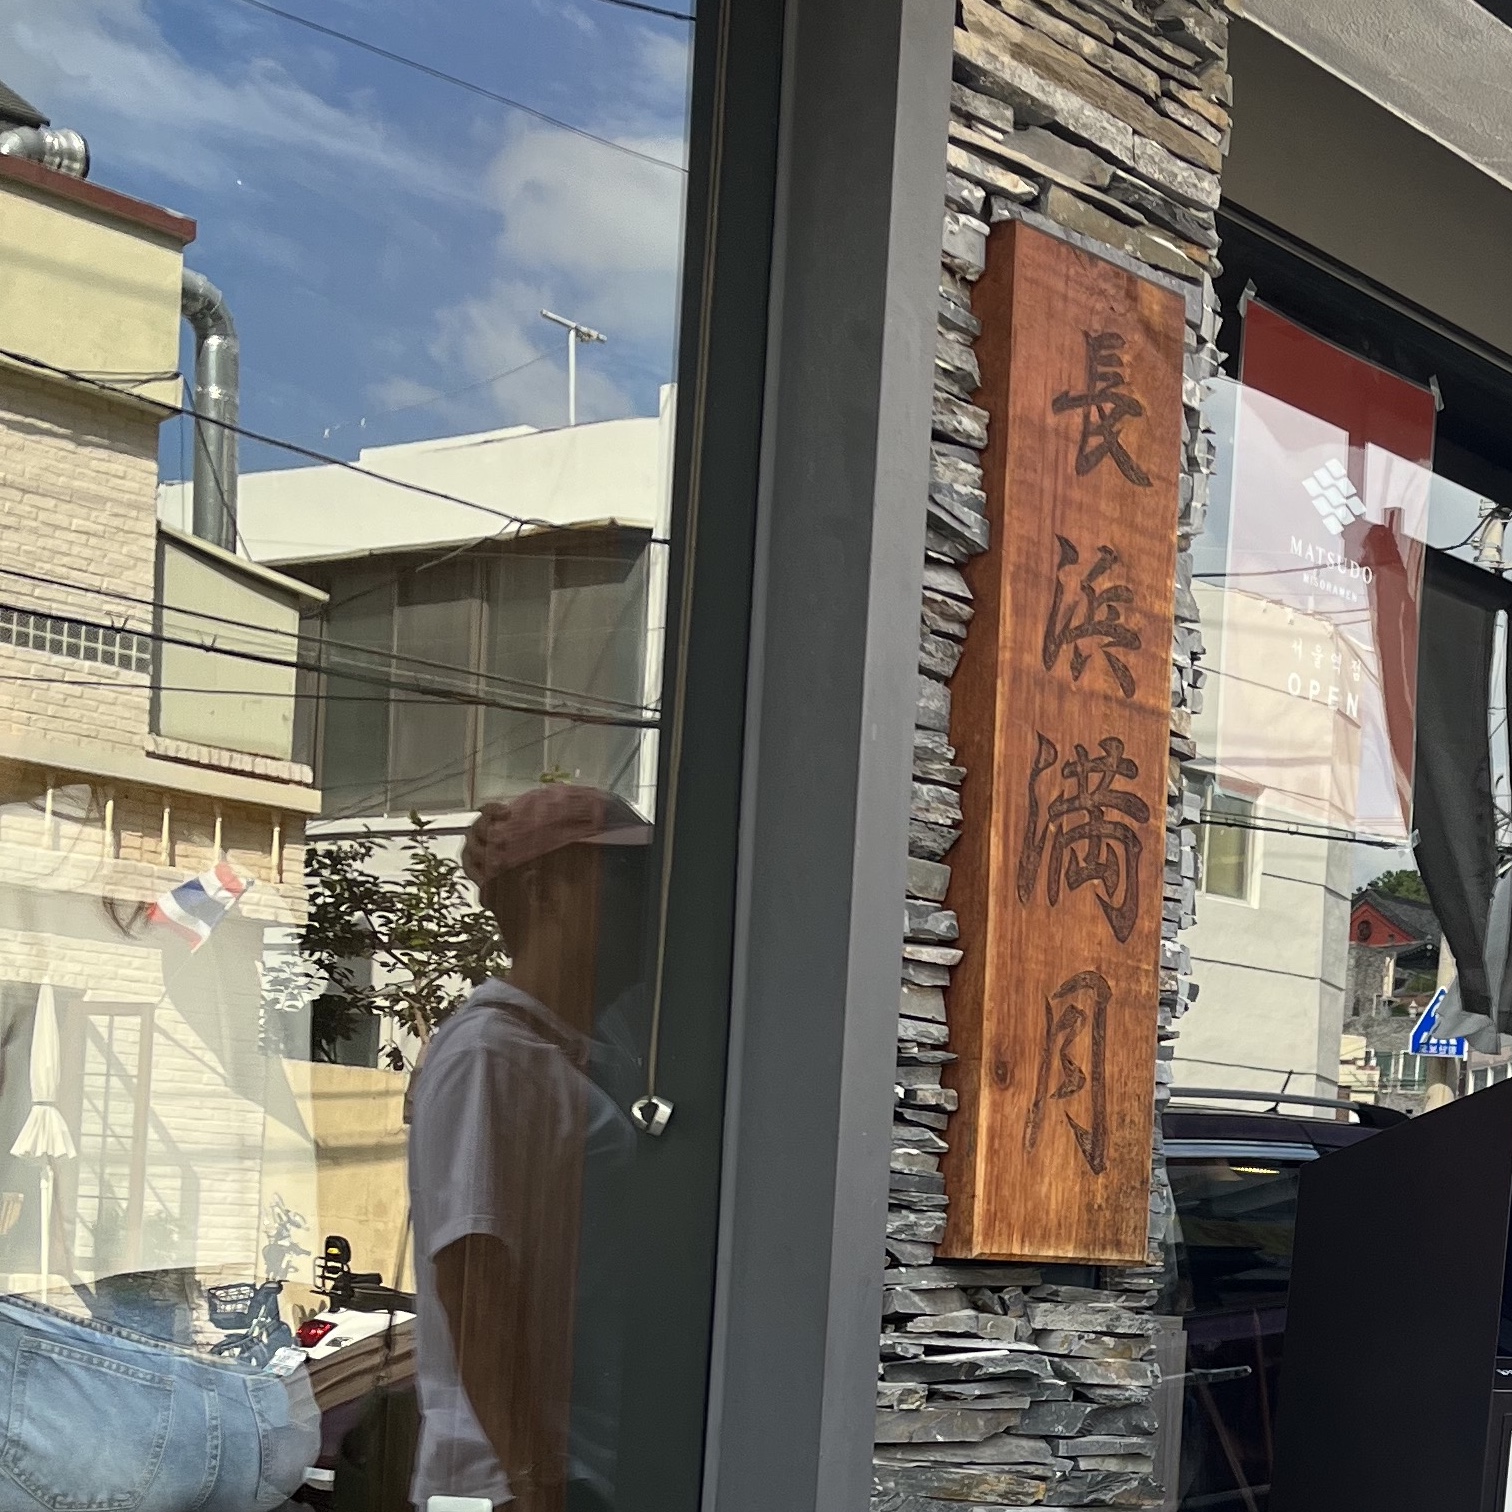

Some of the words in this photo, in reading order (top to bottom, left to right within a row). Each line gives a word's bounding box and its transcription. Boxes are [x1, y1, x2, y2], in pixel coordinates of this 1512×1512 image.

[1290, 535, 1373, 584] MATSUDO
[1303, 572, 1358, 603] MISORAMEN
[1287, 672, 1360, 718] OPEN
